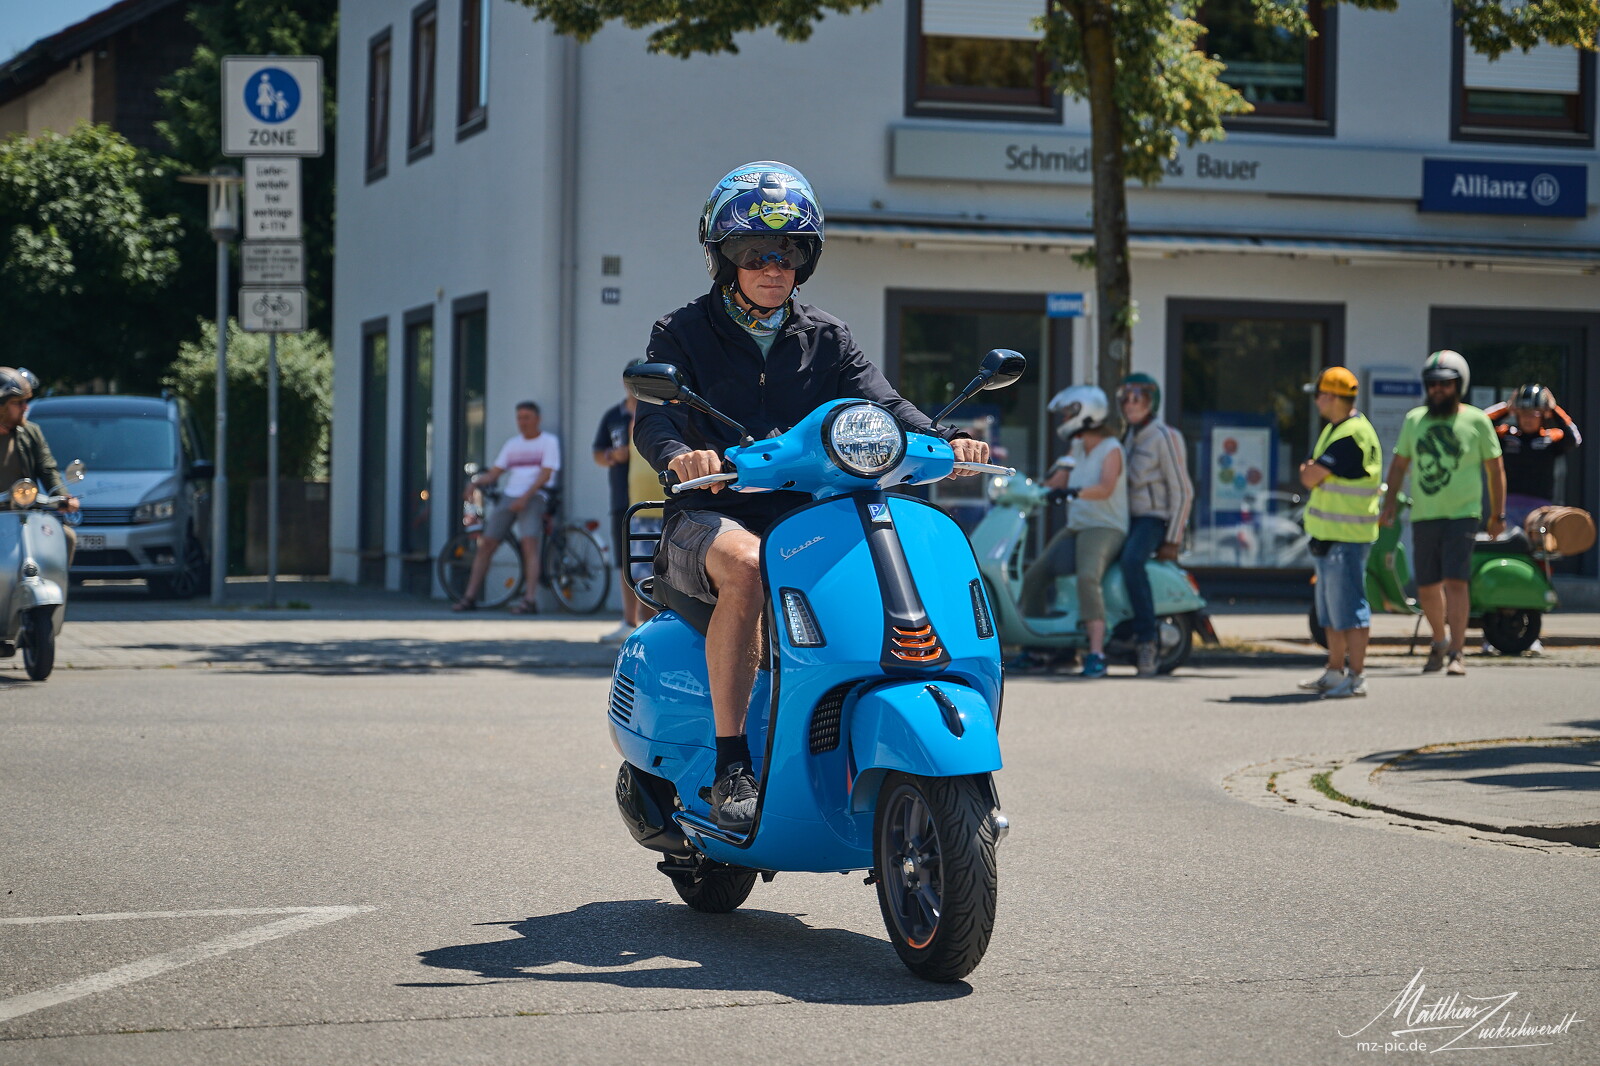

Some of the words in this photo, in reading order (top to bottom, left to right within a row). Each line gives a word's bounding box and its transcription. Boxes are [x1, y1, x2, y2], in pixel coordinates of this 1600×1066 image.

[248, 129, 297, 146] ZONE
[1196, 153, 1260, 180] Bauer
[1451, 173, 1528, 199] Allianz
[780, 535, 826, 561] Vespa
